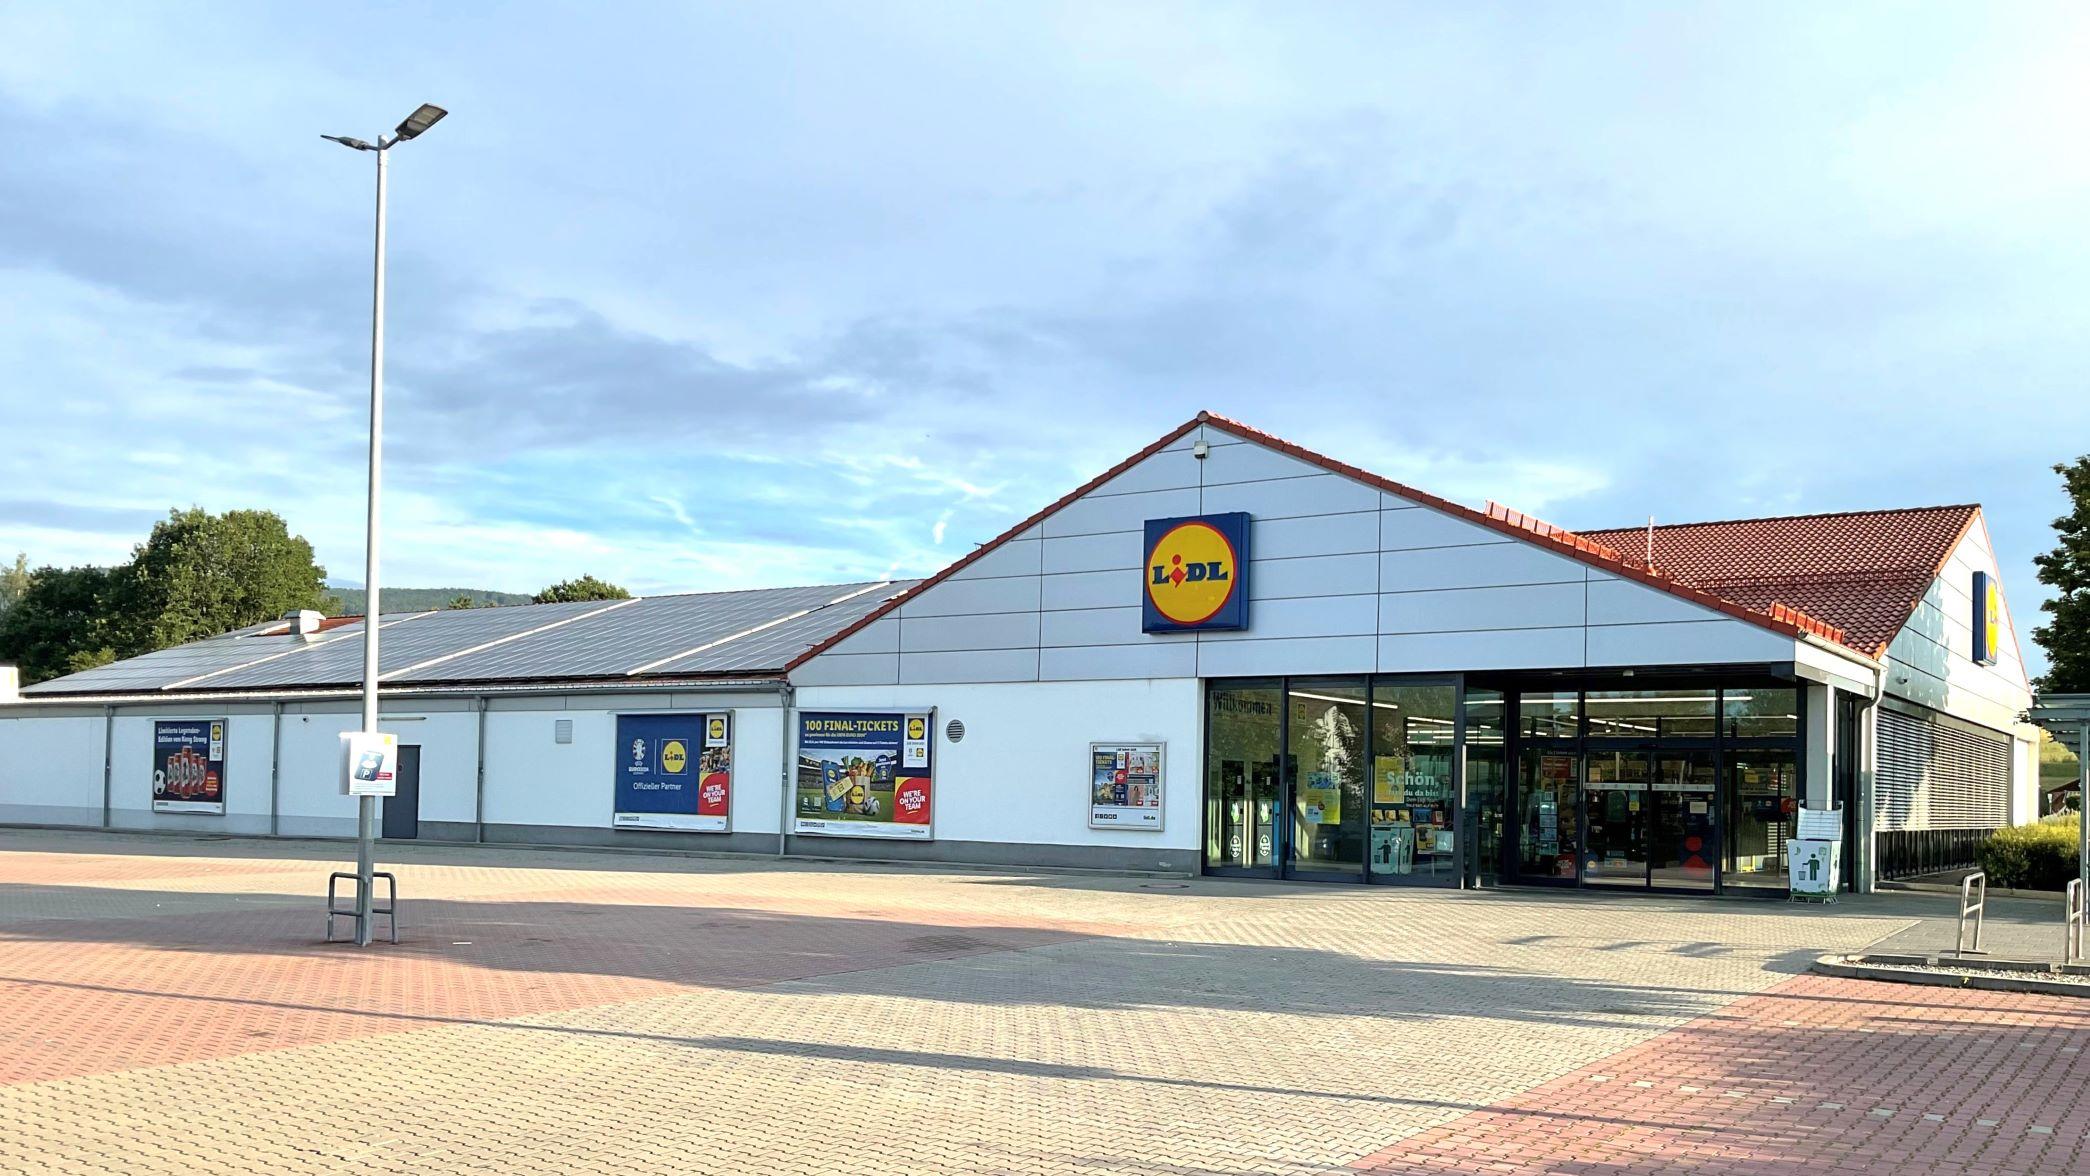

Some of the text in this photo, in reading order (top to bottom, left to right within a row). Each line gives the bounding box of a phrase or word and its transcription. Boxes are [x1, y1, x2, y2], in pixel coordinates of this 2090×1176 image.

[805, 720, 899, 732] 100 FINAL-TICKETS
[1387, 771, 1440, 788] Schön,
[633, 782, 682, 790] Offizieller Partner
[903, 790, 921, 798] WE'RE
[1415, 789, 1424, 797] da
[911, 796, 926, 804] YOUR
[905, 803, 921, 811] TEAM
